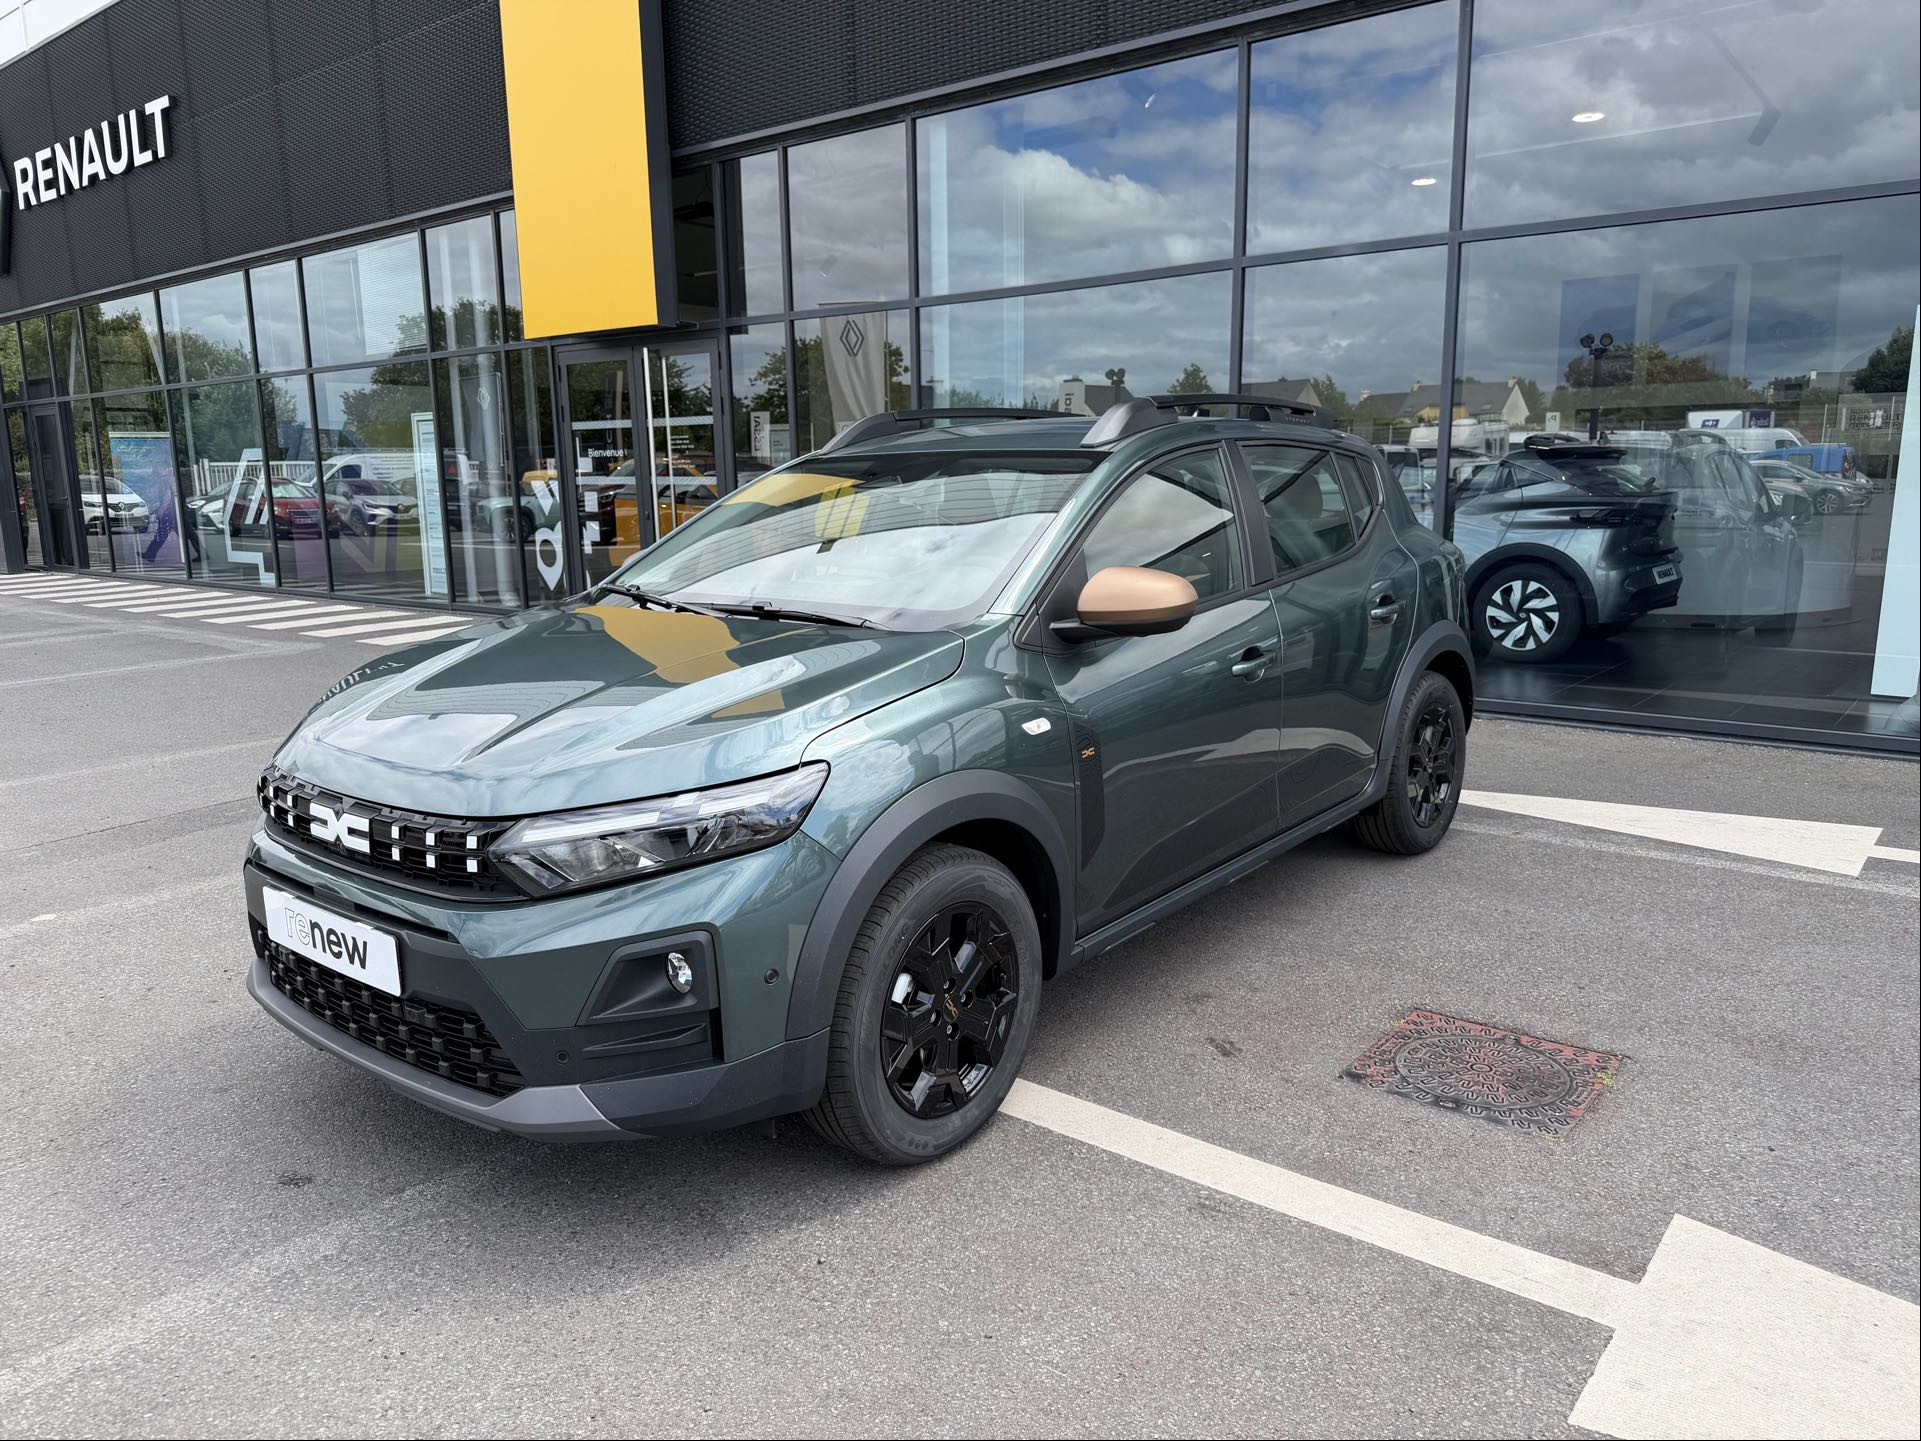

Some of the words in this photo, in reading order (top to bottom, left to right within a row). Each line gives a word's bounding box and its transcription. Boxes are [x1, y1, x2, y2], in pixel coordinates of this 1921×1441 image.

[13, 95, 170, 210] RENAULT
[588, 448, 624, 458] Bienvenue
[284, 906, 368, 970] renew
